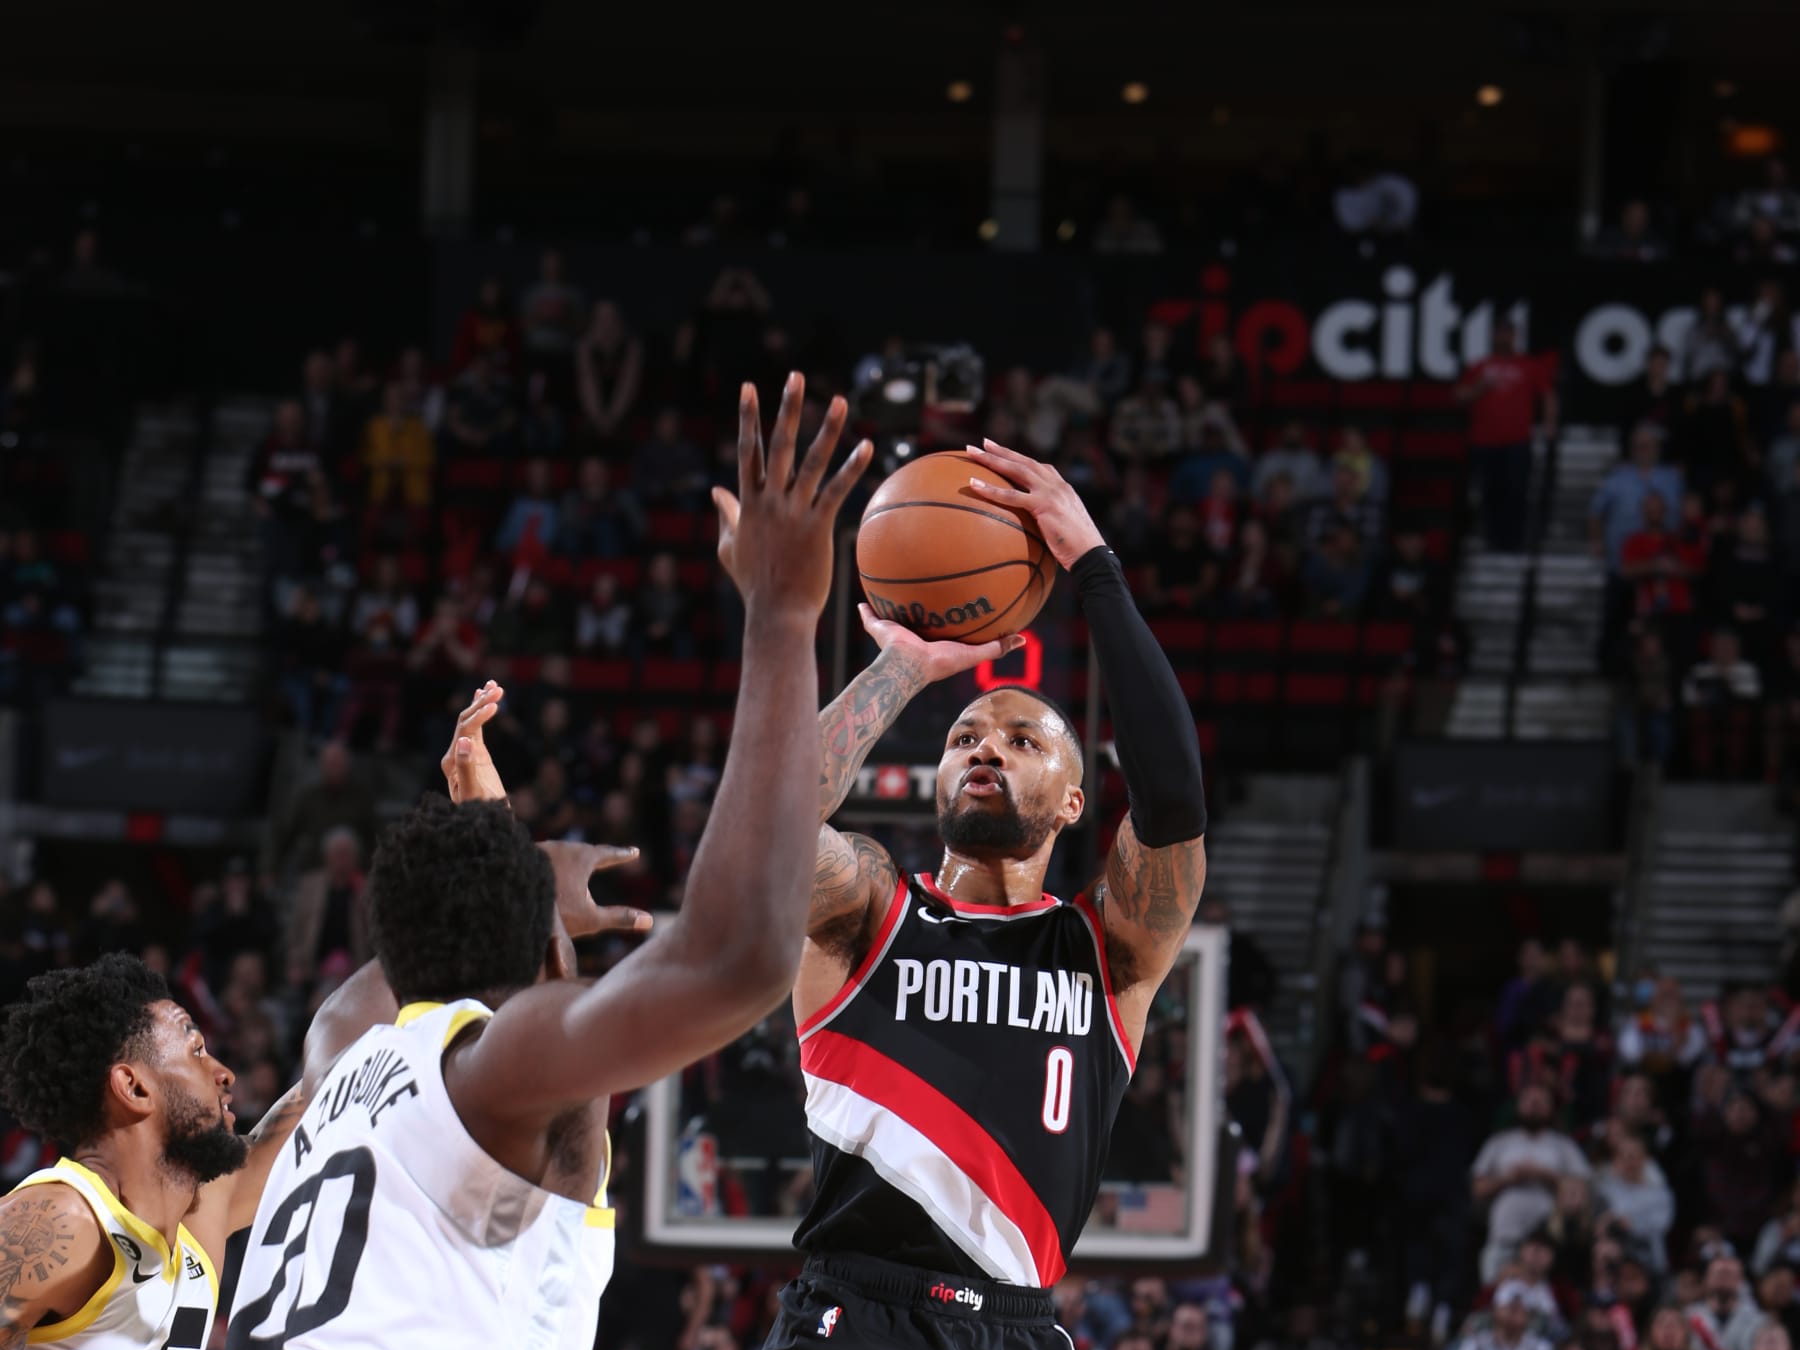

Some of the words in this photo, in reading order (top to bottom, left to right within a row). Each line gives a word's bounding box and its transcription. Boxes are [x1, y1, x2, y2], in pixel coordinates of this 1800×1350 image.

[868, 591, 995, 629] Wilson
[894, 958, 1093, 1036] PORTLAND
[294, 1049, 419, 1170] AZUBUIKE
[1041, 1046, 1074, 1134] 0
[930, 1281, 983, 1311] ripcity
